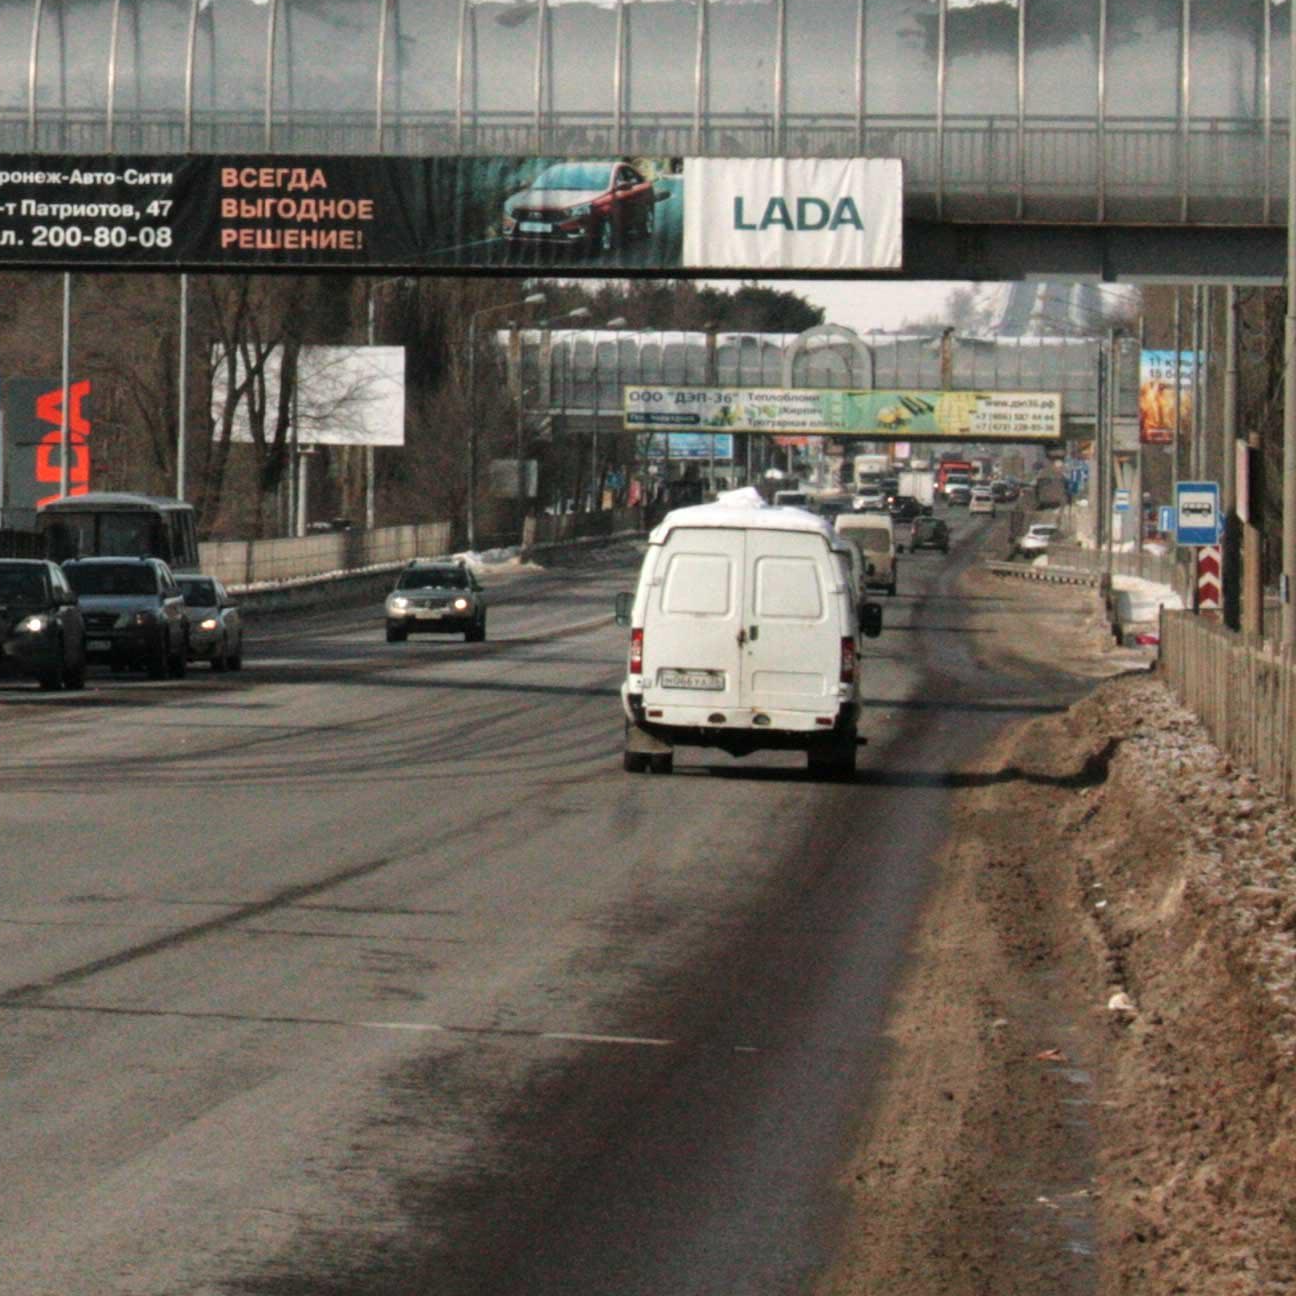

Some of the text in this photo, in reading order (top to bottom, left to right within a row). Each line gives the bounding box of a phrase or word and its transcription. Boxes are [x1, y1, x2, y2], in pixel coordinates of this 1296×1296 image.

[221, 167, 328, 192] ВСЕГДА
[21, 199, 140, 219] Патриотов,
[146, 200, 172, 217] 47
[221, 198, 374, 222] ВЫГОДНОЕ
[734, 196, 864, 231] LADA
[32, 225, 173, 248] 200-80-08
[221, 228, 363, 249] РЕШЕНИЕ!
[629, 391, 663, 403] ООО
